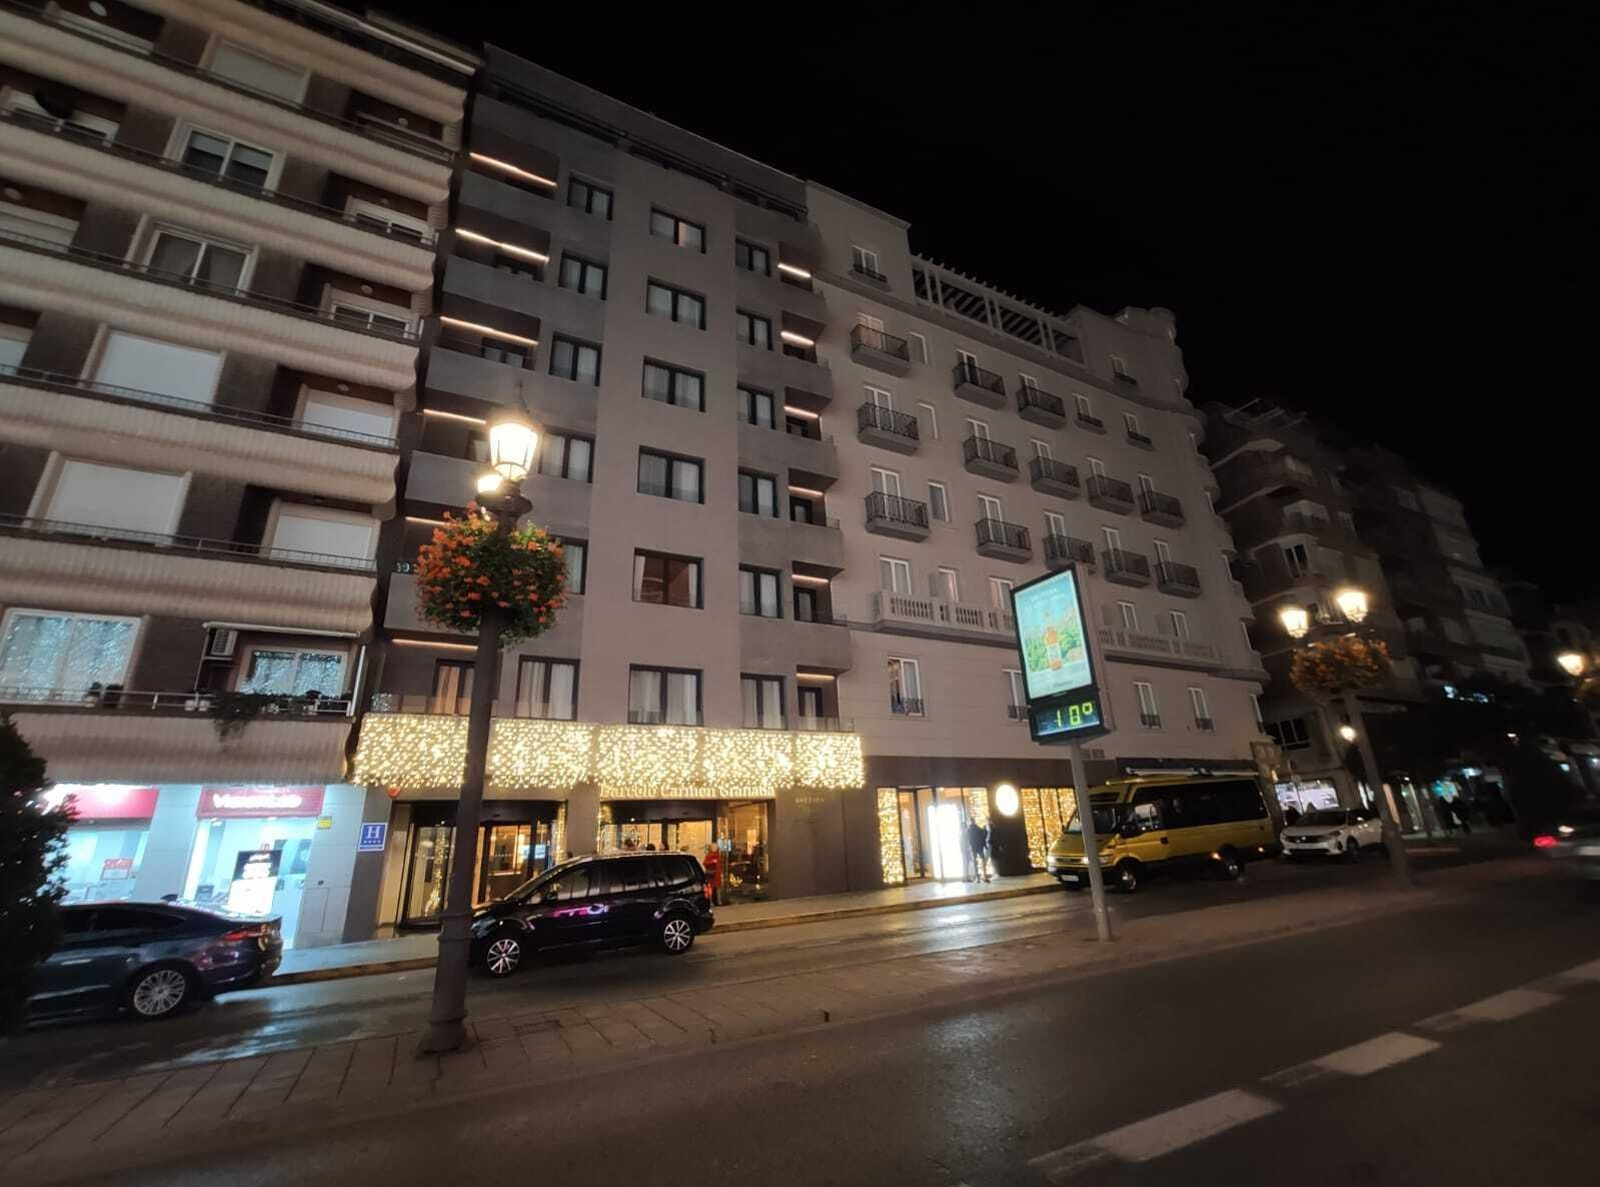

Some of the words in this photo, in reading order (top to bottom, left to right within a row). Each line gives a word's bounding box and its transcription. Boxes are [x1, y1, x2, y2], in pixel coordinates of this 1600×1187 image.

[660, 782, 716, 798] Carmen
[719, 783, 775, 798] Granada
[366, 825, 381, 839] H
